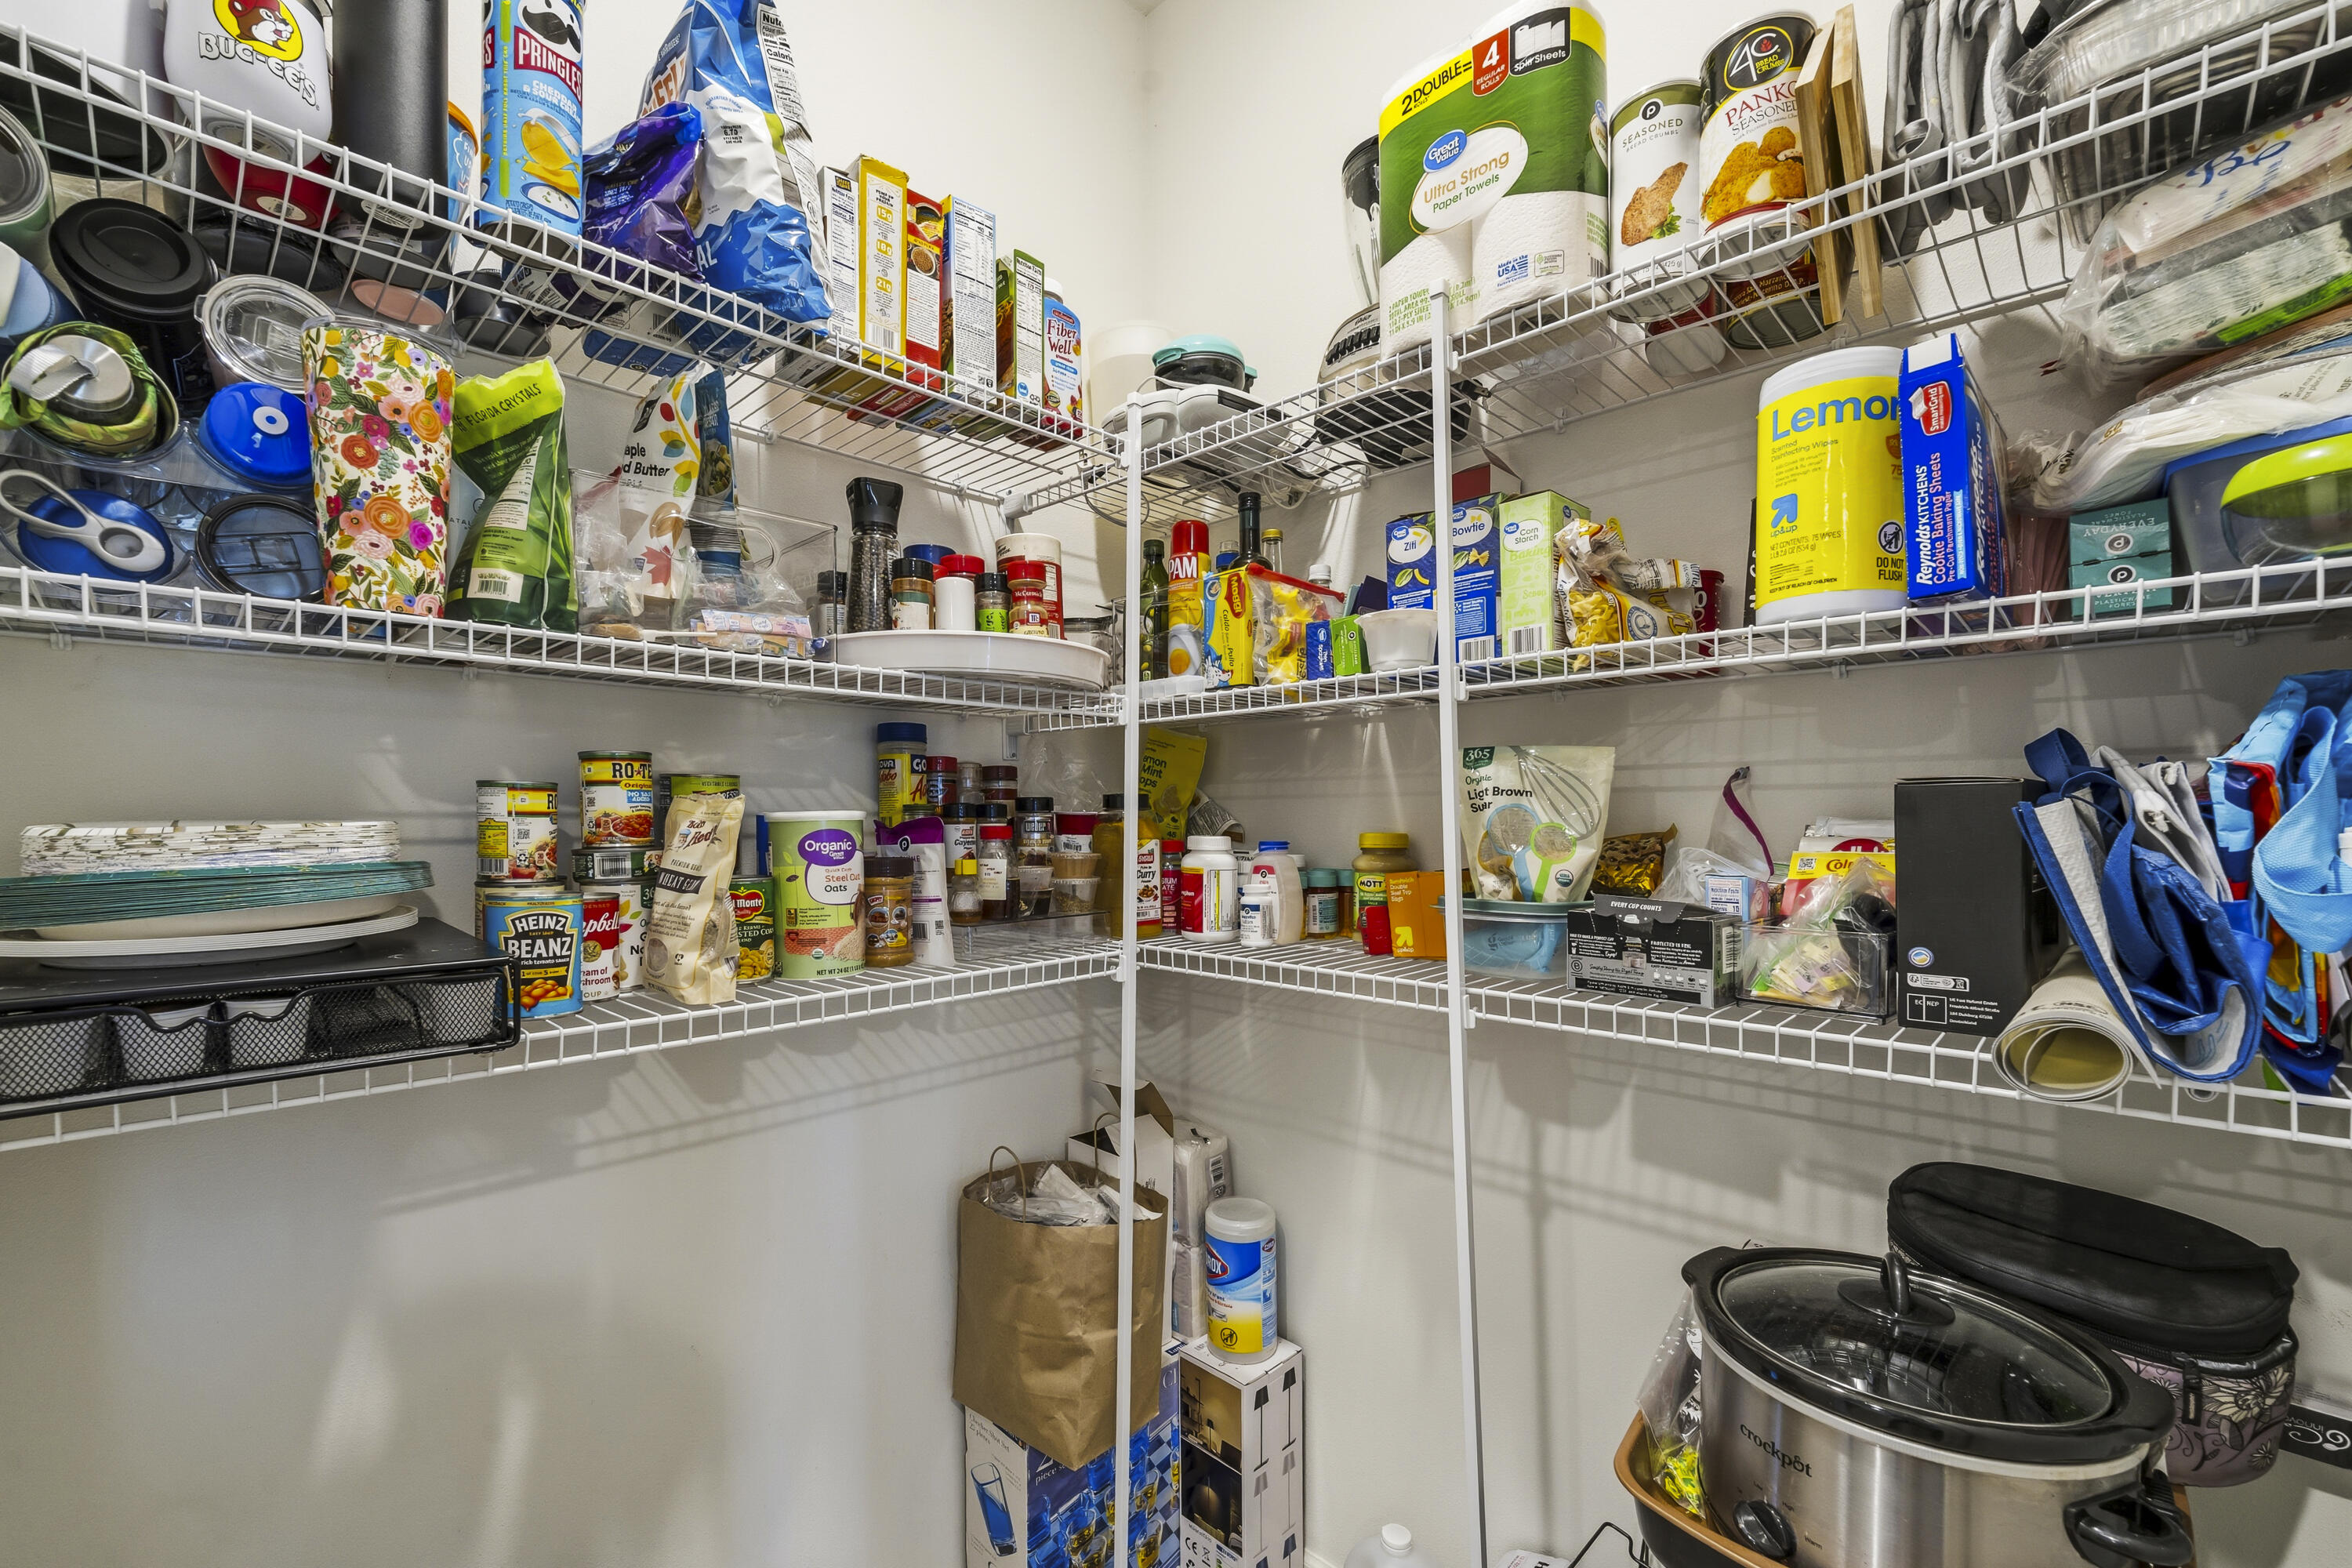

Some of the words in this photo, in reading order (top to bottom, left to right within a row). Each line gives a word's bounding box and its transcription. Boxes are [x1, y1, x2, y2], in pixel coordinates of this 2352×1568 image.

[1483, 40, 1499, 69] 4
[1534, 49, 1566, 64] Sheets
[1729, 32, 1779, 82] 4C
[1755, 54, 1778, 67] BREAD
[518, 31, 583, 101] PRINGLES
[1476, 64, 1504, 85] REGULAR
[1622, 118, 1683, 148] SEASONED
[1428, 136, 1460, 160] Great
[1436, 146, 1461, 164] Value
[1424, 179, 1457, 204] Ultra
[1461, 151, 1510, 186] Strong
[1433, 191, 1462, 213] Paper
[1465, 173, 1500, 197] Towels
[877, 206, 892, 222] 15g
[1497, 265, 1517, 278] USA
[877, 279, 892, 292] 21g
[1047, 318, 1076, 339] Fiber
[1048, 337, 1073, 354] Well
[468, 405, 500, 428] FLORIDA
[499, 383, 542, 412] CRYSTALS
[1929, 387, 1939, 432] SmartGrid
[624, 442, 646, 459] aple
[1812, 438, 1838, 451] Wipes
[633, 462, 670, 477] Butter
[1929, 452, 1942, 494] Sheets
[1931, 495, 1947, 539] Baking
[1453, 521, 1486, 537] Bowtie
[1519, 526, 1539, 536] Corn
[1770, 524, 1798, 539] up&up
[1819, 530, 1842, 540] WIPES
[2083, 517, 2155, 537] EVERYDAY
[1403, 540, 1417, 552] Ziti
[1515, 533, 1539, 545] Starch
[1168, 556, 1198, 579] PAM
[1876, 557, 1889, 568] DO
[1890, 557, 1904, 569] NOT
[1933, 540, 1945, 584] Cookie
[1947, 553, 1955, 583] Pre-Cut
[1878, 568, 1903, 582] FLUSH
[1465, 748, 1490, 761] 365
[913, 758, 927, 771] GO
[1142, 764, 1163, 779] Mint
[1139, 776, 1158, 788] ops
[1492, 786, 1533, 798] Brown
[804, 838, 852, 855] Organic
[825, 873, 849, 883] Steel
[1137, 869, 1156, 881] Curry
[824, 884, 848, 893] Oats
[736, 898, 763, 909] Monte
[1610, 901, 1629, 909] EVERY
[1639, 903, 1662, 912] COUNTS
[514, 915, 567, 933] HEINZ
[583, 912, 619, 938] pbell
[507, 937, 572, 958] BEANZ
[583, 967, 600, 977] ream
[600, 967, 608, 975] of
[1740, 1424, 1813, 1478] crockpot
[1035, 1468, 1058, 1486] piece
